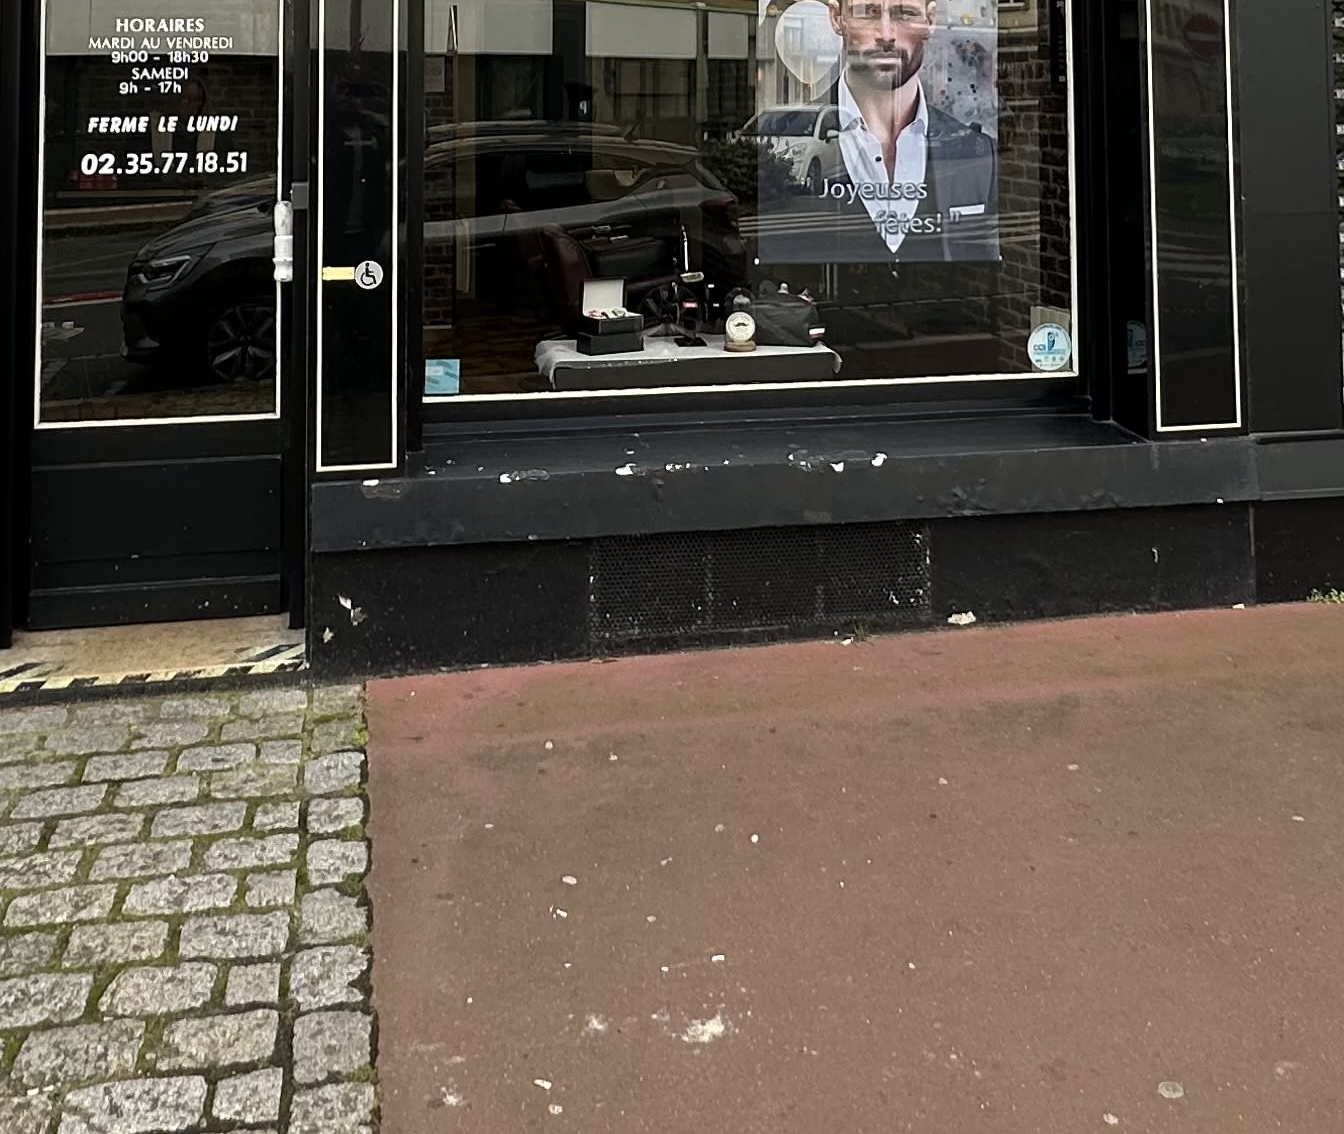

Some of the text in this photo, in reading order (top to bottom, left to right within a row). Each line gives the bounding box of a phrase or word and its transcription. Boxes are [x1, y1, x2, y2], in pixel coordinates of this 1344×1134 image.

[115, 18, 205, 33] HORAIRES
[88, 36, 233, 49] MARDI AU VENDREDI
[111, 50, 149, 64] 9h00
[169, 50, 209, 64] 18h30
[131, 67, 189, 80] SAMEDI
[119, 81, 138, 94] 9h
[158, 81, 182, 94] 17h
[88, 115, 238, 133] FERME LE LUNDI
[81, 151, 248, 176] 02.35.77.18.51
[818, 178, 928, 205] Joyeuses
